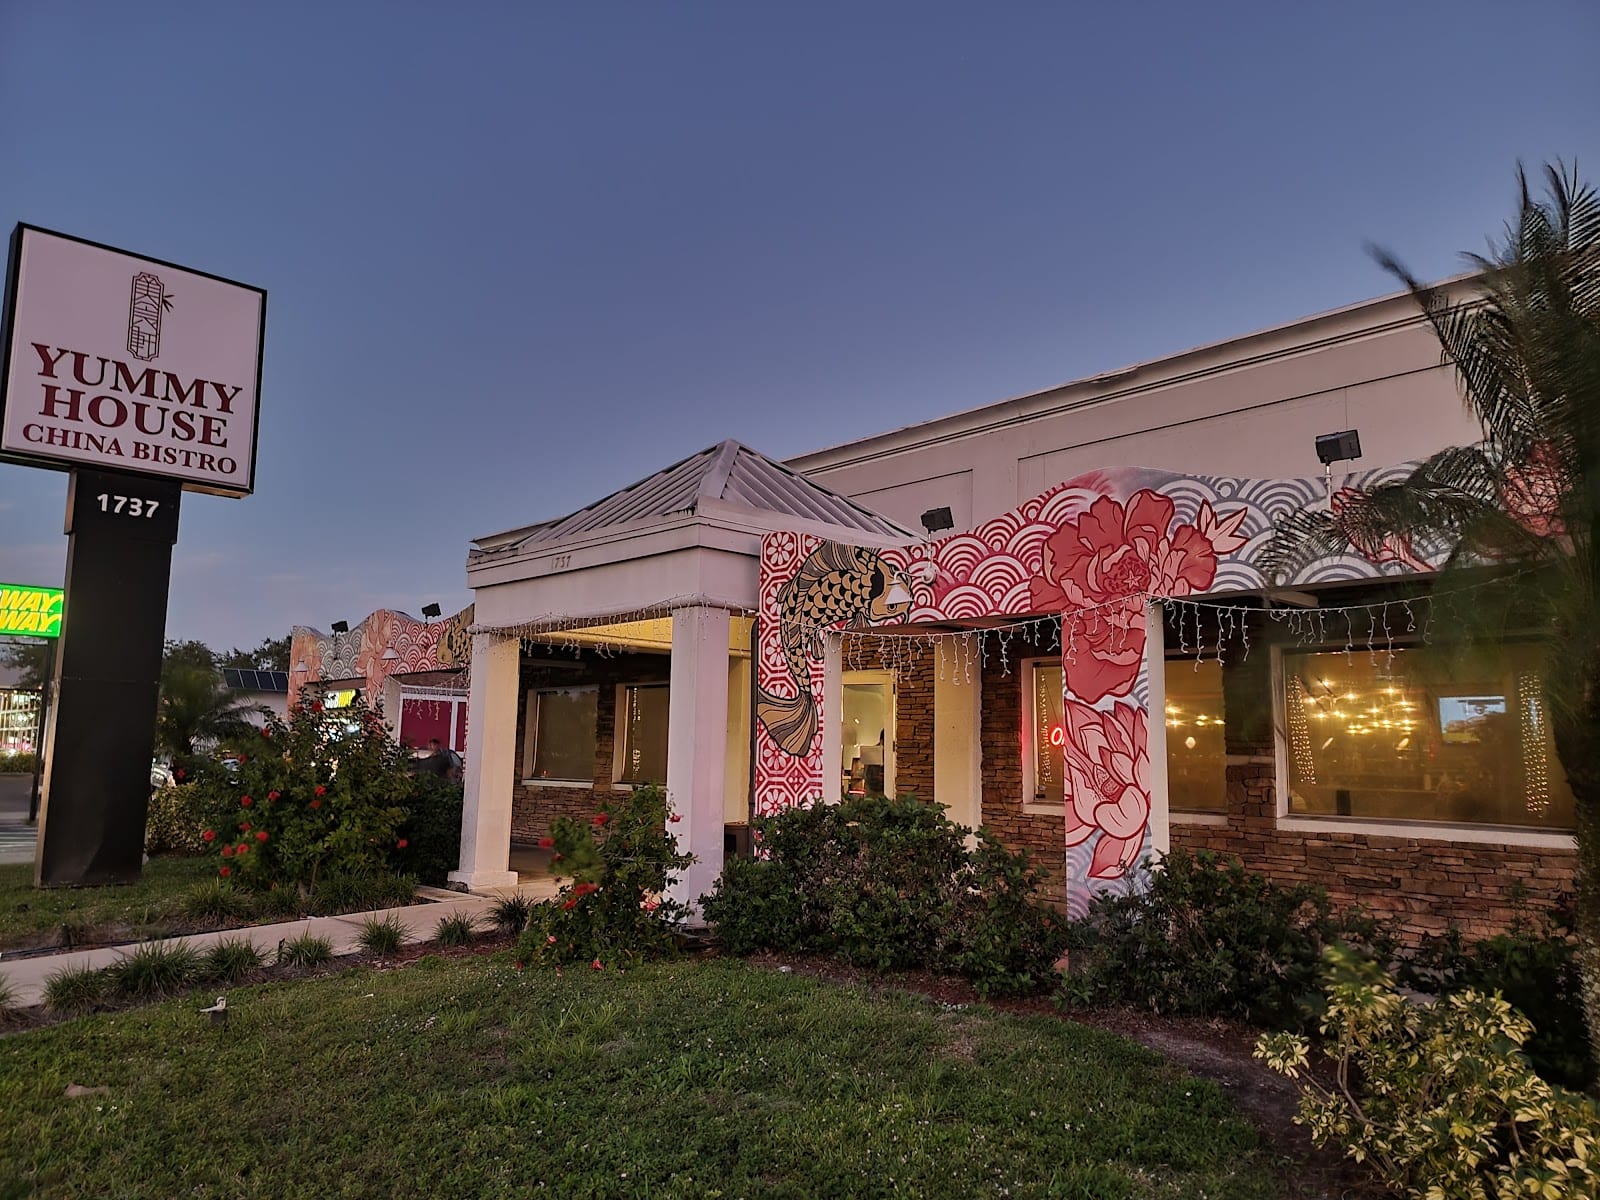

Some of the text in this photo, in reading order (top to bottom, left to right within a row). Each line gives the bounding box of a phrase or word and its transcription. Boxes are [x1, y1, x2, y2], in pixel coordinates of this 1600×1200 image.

[31, 342, 243, 414] YUMMY
[38, 384, 228, 448] HOUSE
[22, 423, 237, 474] CHINA BISTRO
[97, 493, 159, 518] 1737
[0, 589, 64, 612] WAY
